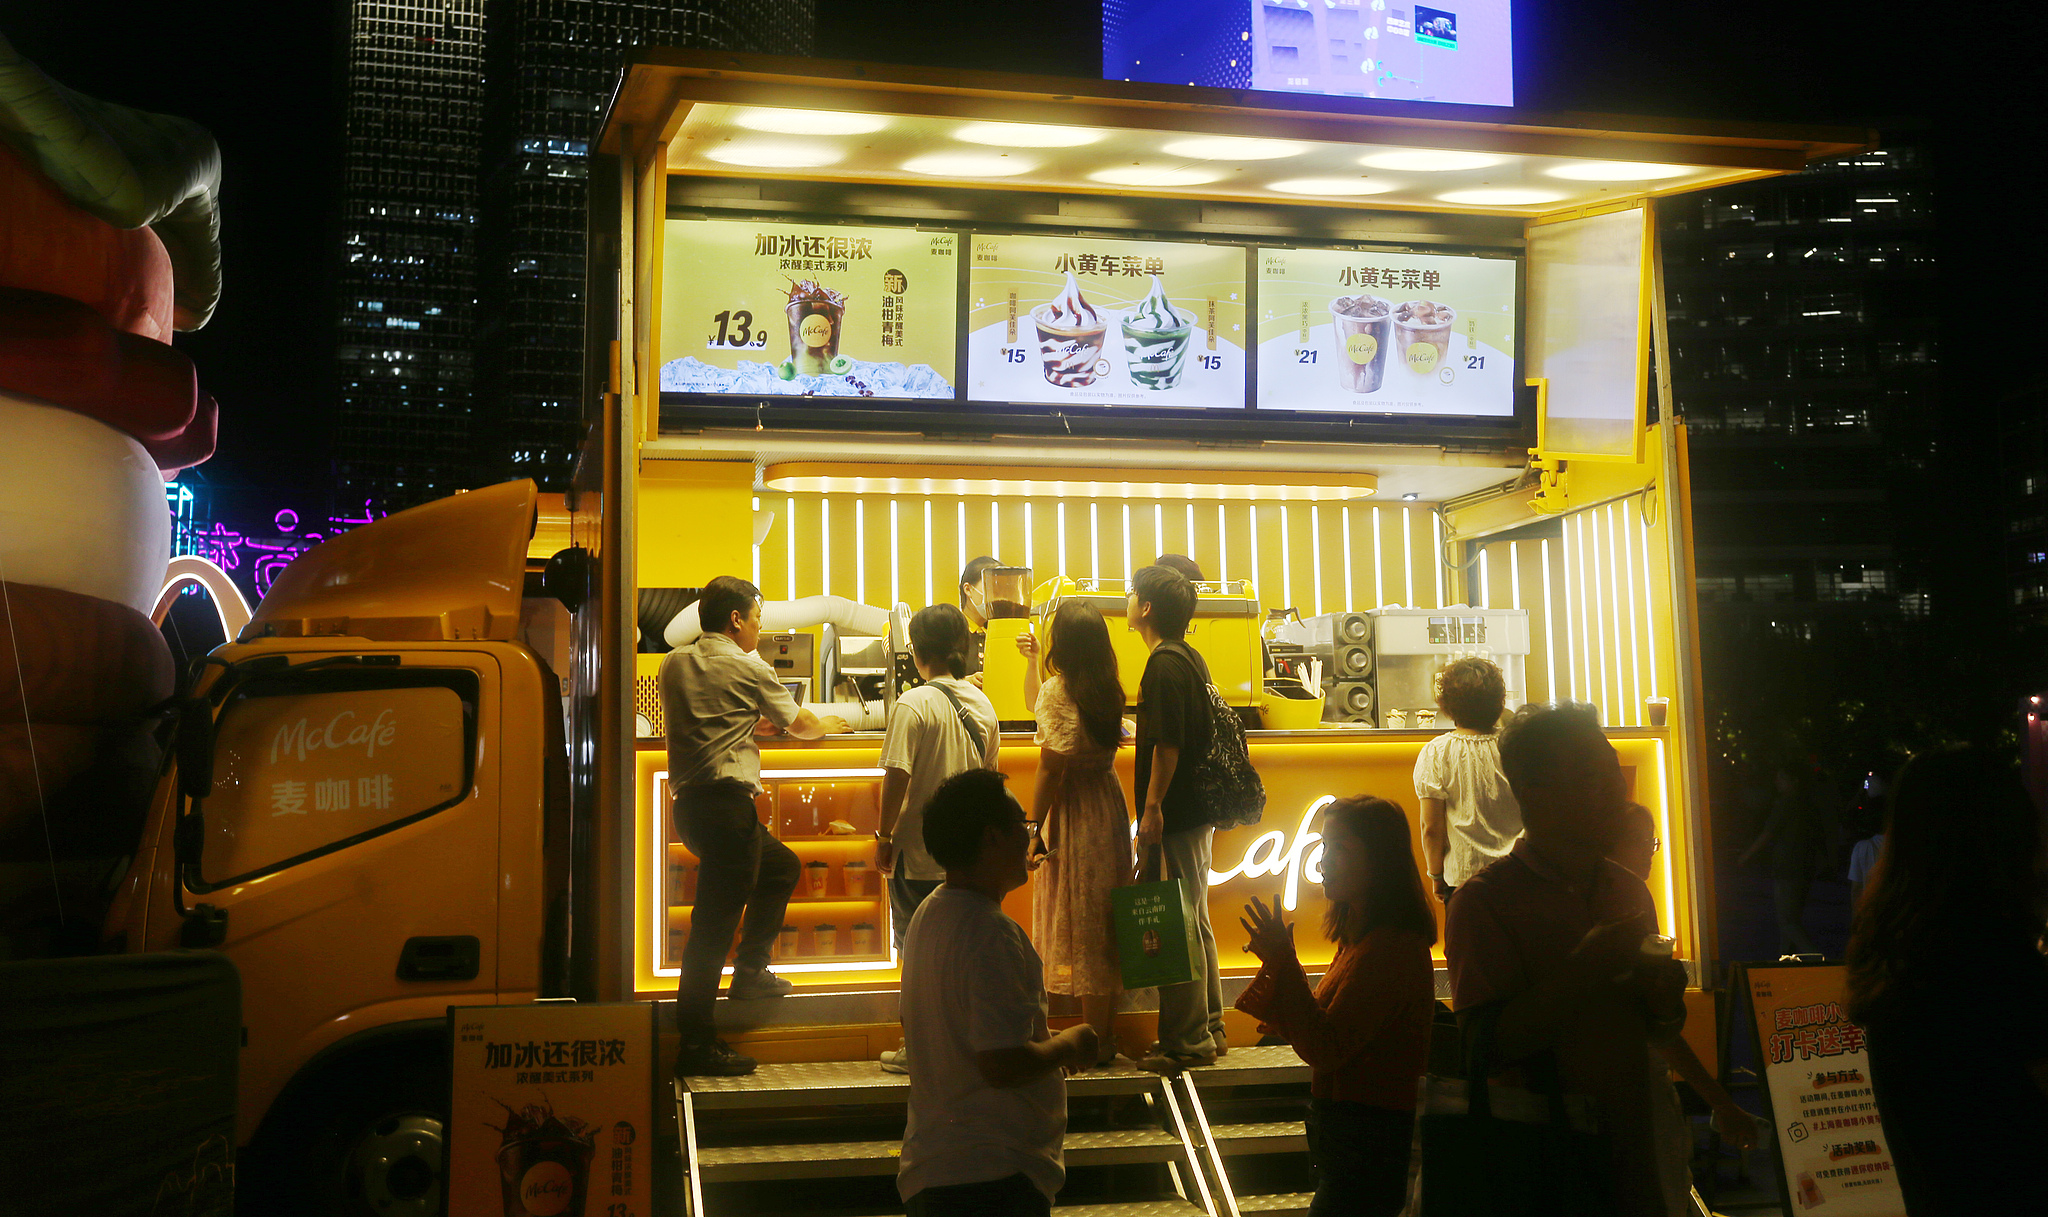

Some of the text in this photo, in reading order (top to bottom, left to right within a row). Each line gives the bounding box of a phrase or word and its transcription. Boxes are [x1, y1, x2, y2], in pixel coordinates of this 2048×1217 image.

[754, 233, 872, 260] 加冰还很浓
[779, 259, 848, 272] 浓醒美式系列
[1054, 253, 1165, 278] 小黄车菜单
[884, 274, 903, 293] 新
[1338, 266, 1441, 290] 小黄车菜单
[882, 296, 894, 347] 油柑青梅
[1001, 348, 1026, 363] ¥15
[1198, 354, 1221, 370] ¥15
[1295, 350, 1318, 364] ¥21
[1464, 355, 1485, 370] ¥21
[270, 709, 396, 764] McCafé
[271, 774, 394, 817] 麦咖啡
[485, 1039, 626, 1068] 加冰还很浓
[1770, 1024, 1868, 1064] 打卡送幸
[516, 1070, 594, 1084] 浓醒美式系列
[1816, 1068, 1860, 1085] 参与方式
[1832, 1140, 1877, 1157] 活动奖励
[526, 1179, 569, 1200] McCafé
